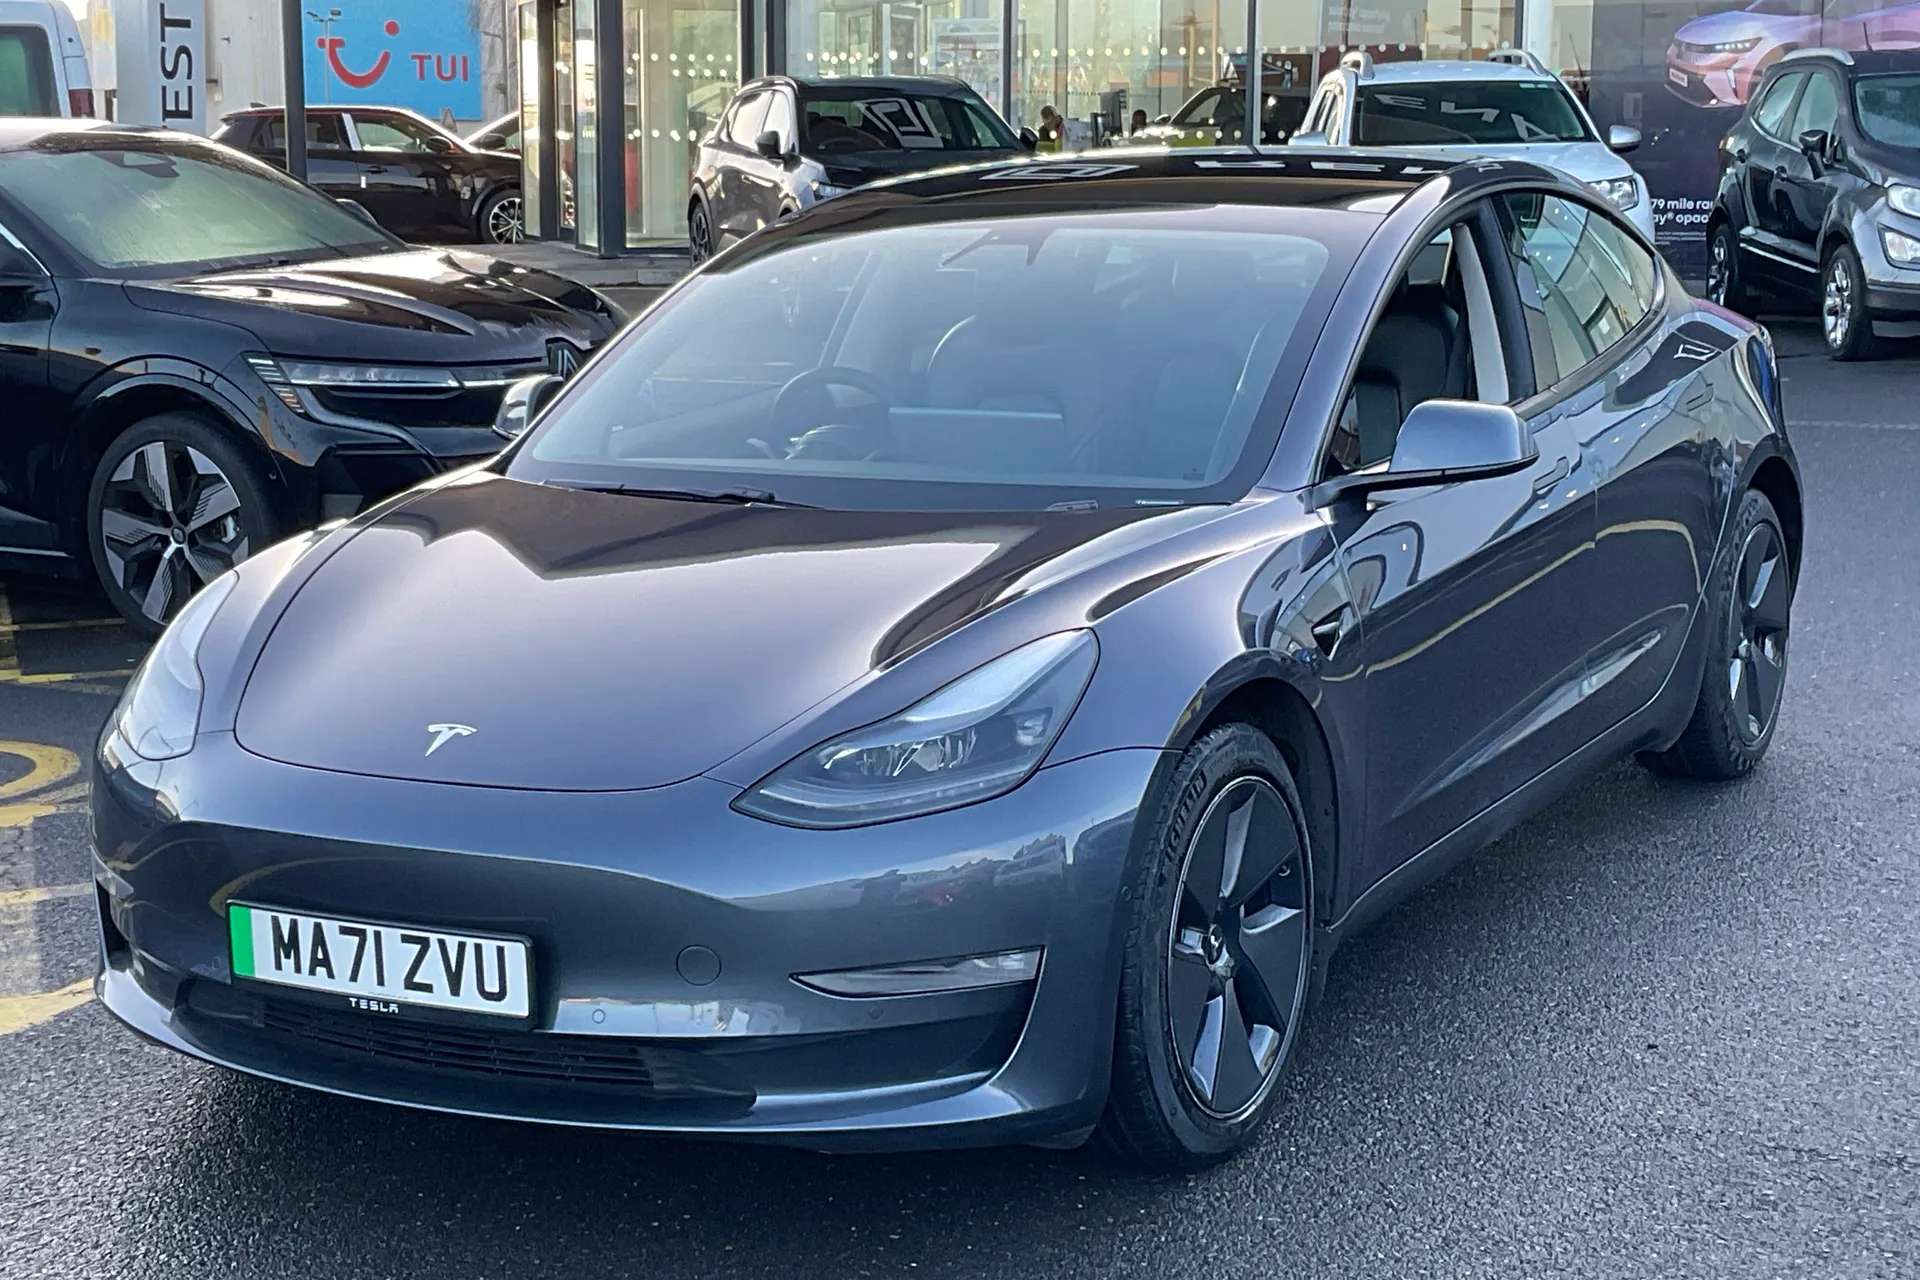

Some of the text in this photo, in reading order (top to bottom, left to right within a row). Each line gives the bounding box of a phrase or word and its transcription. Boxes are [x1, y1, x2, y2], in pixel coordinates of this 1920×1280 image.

[160, 2, 193, 128] EST
[410, 53, 469, 82] TUI
[1667, 197, 1694, 210] mile
[270, 914, 508, 1002] MA71 ZVU
[348, 997, 399, 1014] TESLA
